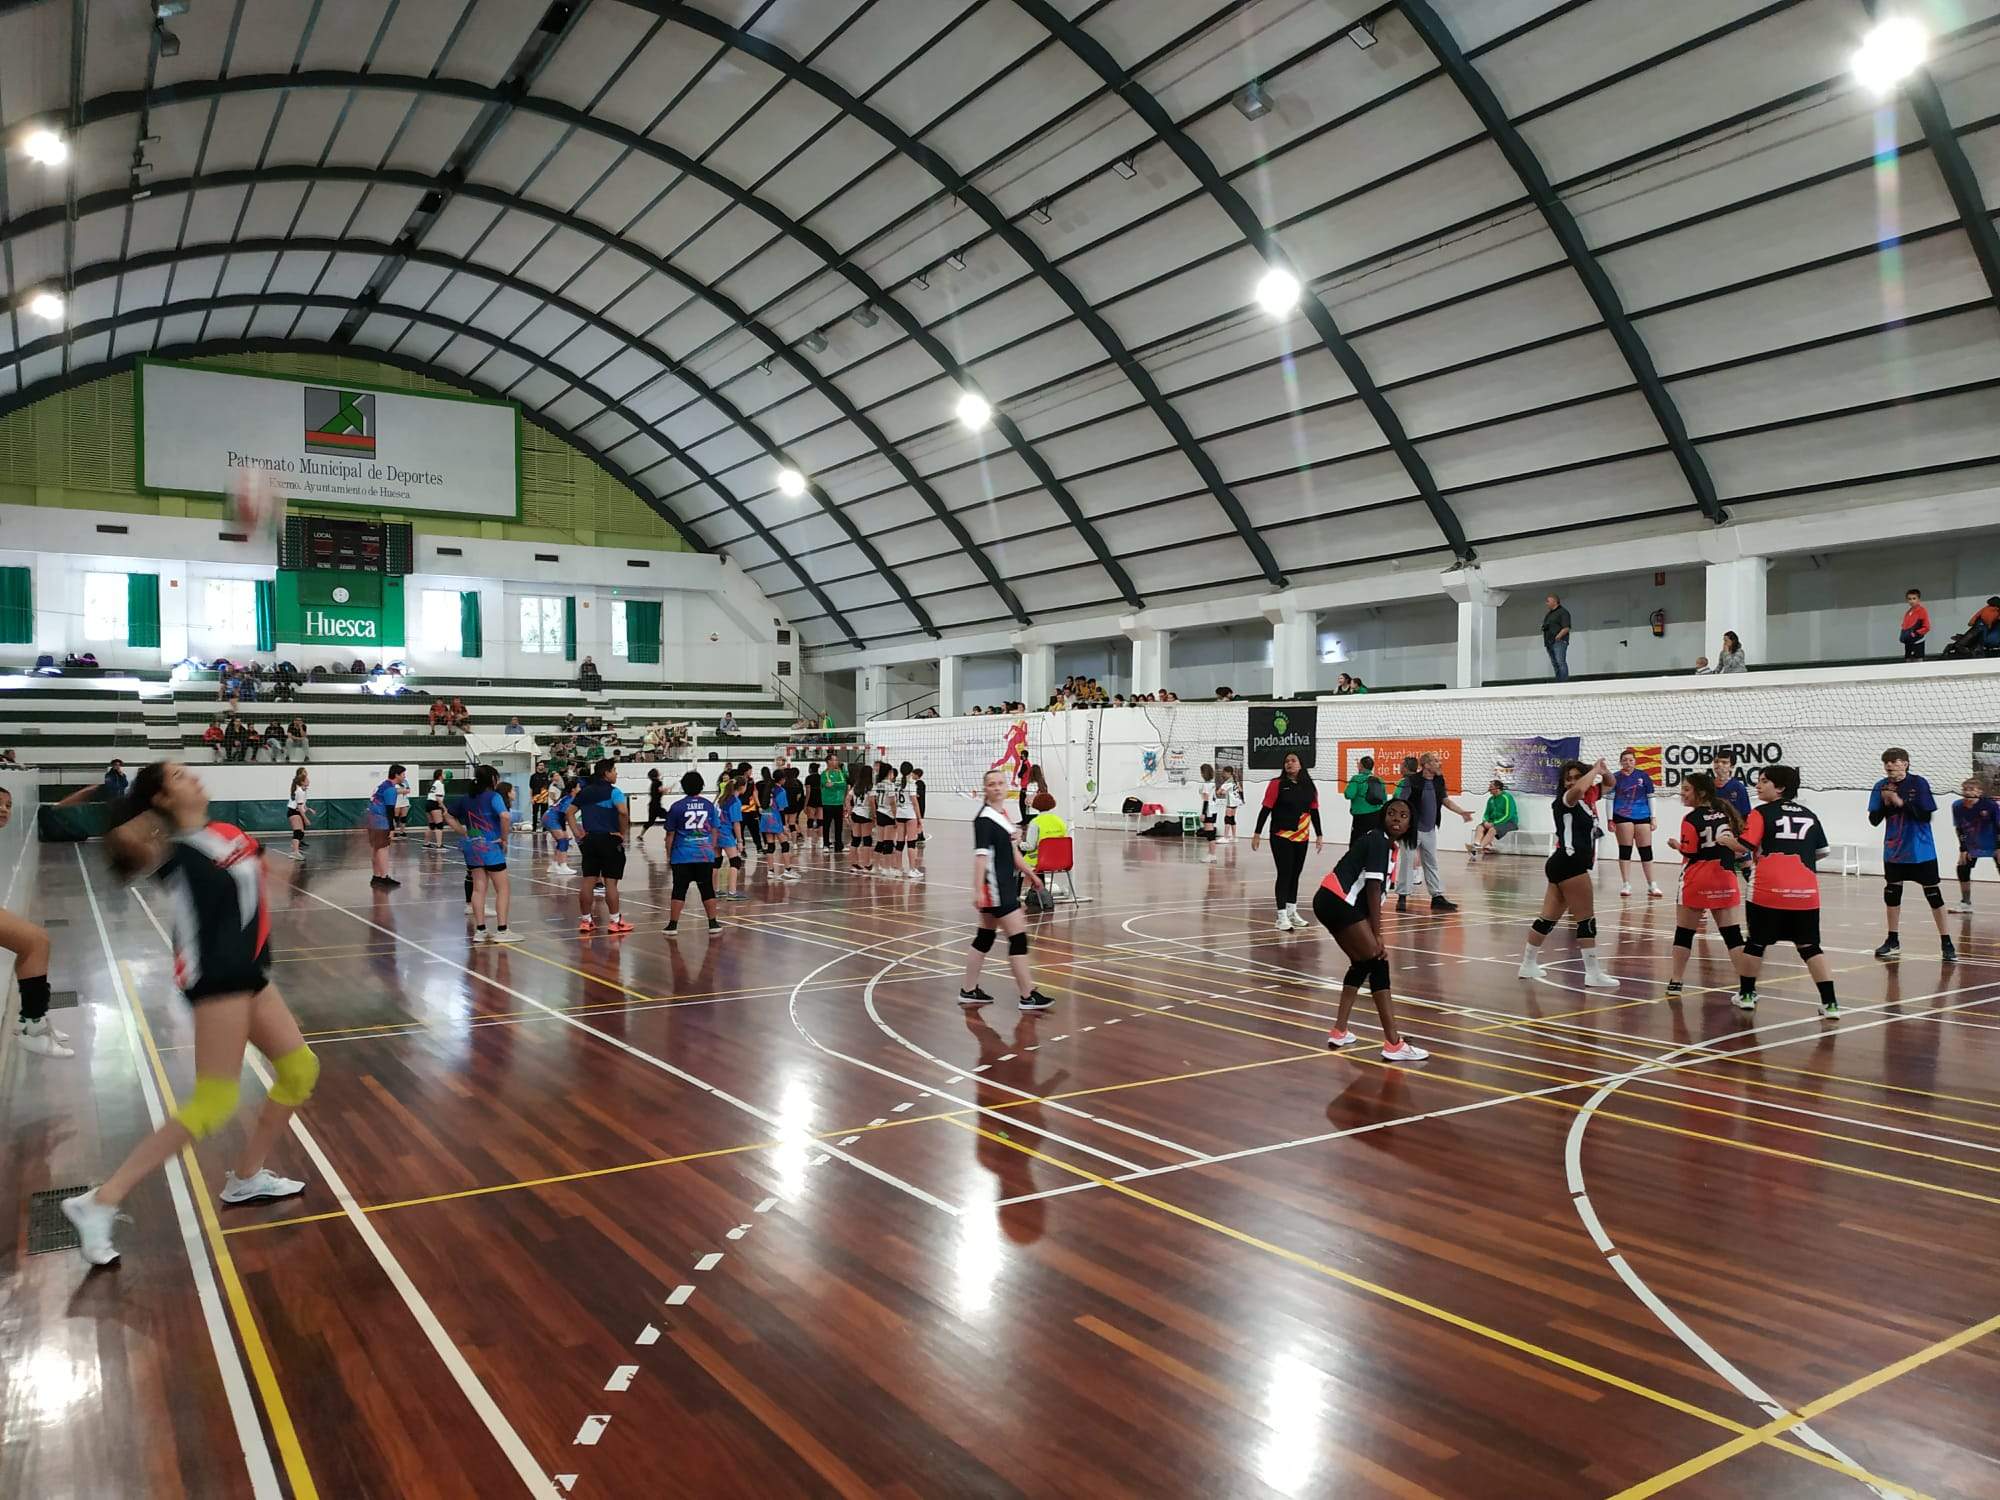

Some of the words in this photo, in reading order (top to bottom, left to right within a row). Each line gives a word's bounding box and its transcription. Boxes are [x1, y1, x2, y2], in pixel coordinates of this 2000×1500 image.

[228, 451, 295, 473] Patronato
[300, 457, 362, 480] Municipal
[367, 463, 383, 480] de
[387, 465, 444, 486] Deportes
[304, 480, 367, 495] Ayuntamiento
[368, 485, 379, 496] de
[380, 487, 411, 499] Huesca
[305, 611, 377, 638] Huesca
[1253, 732, 1310, 752] podoactiva
[1377, 764, 1390, 775] de
[684, 810, 708, 829] 27
[1774, 815, 1815, 840] 17
